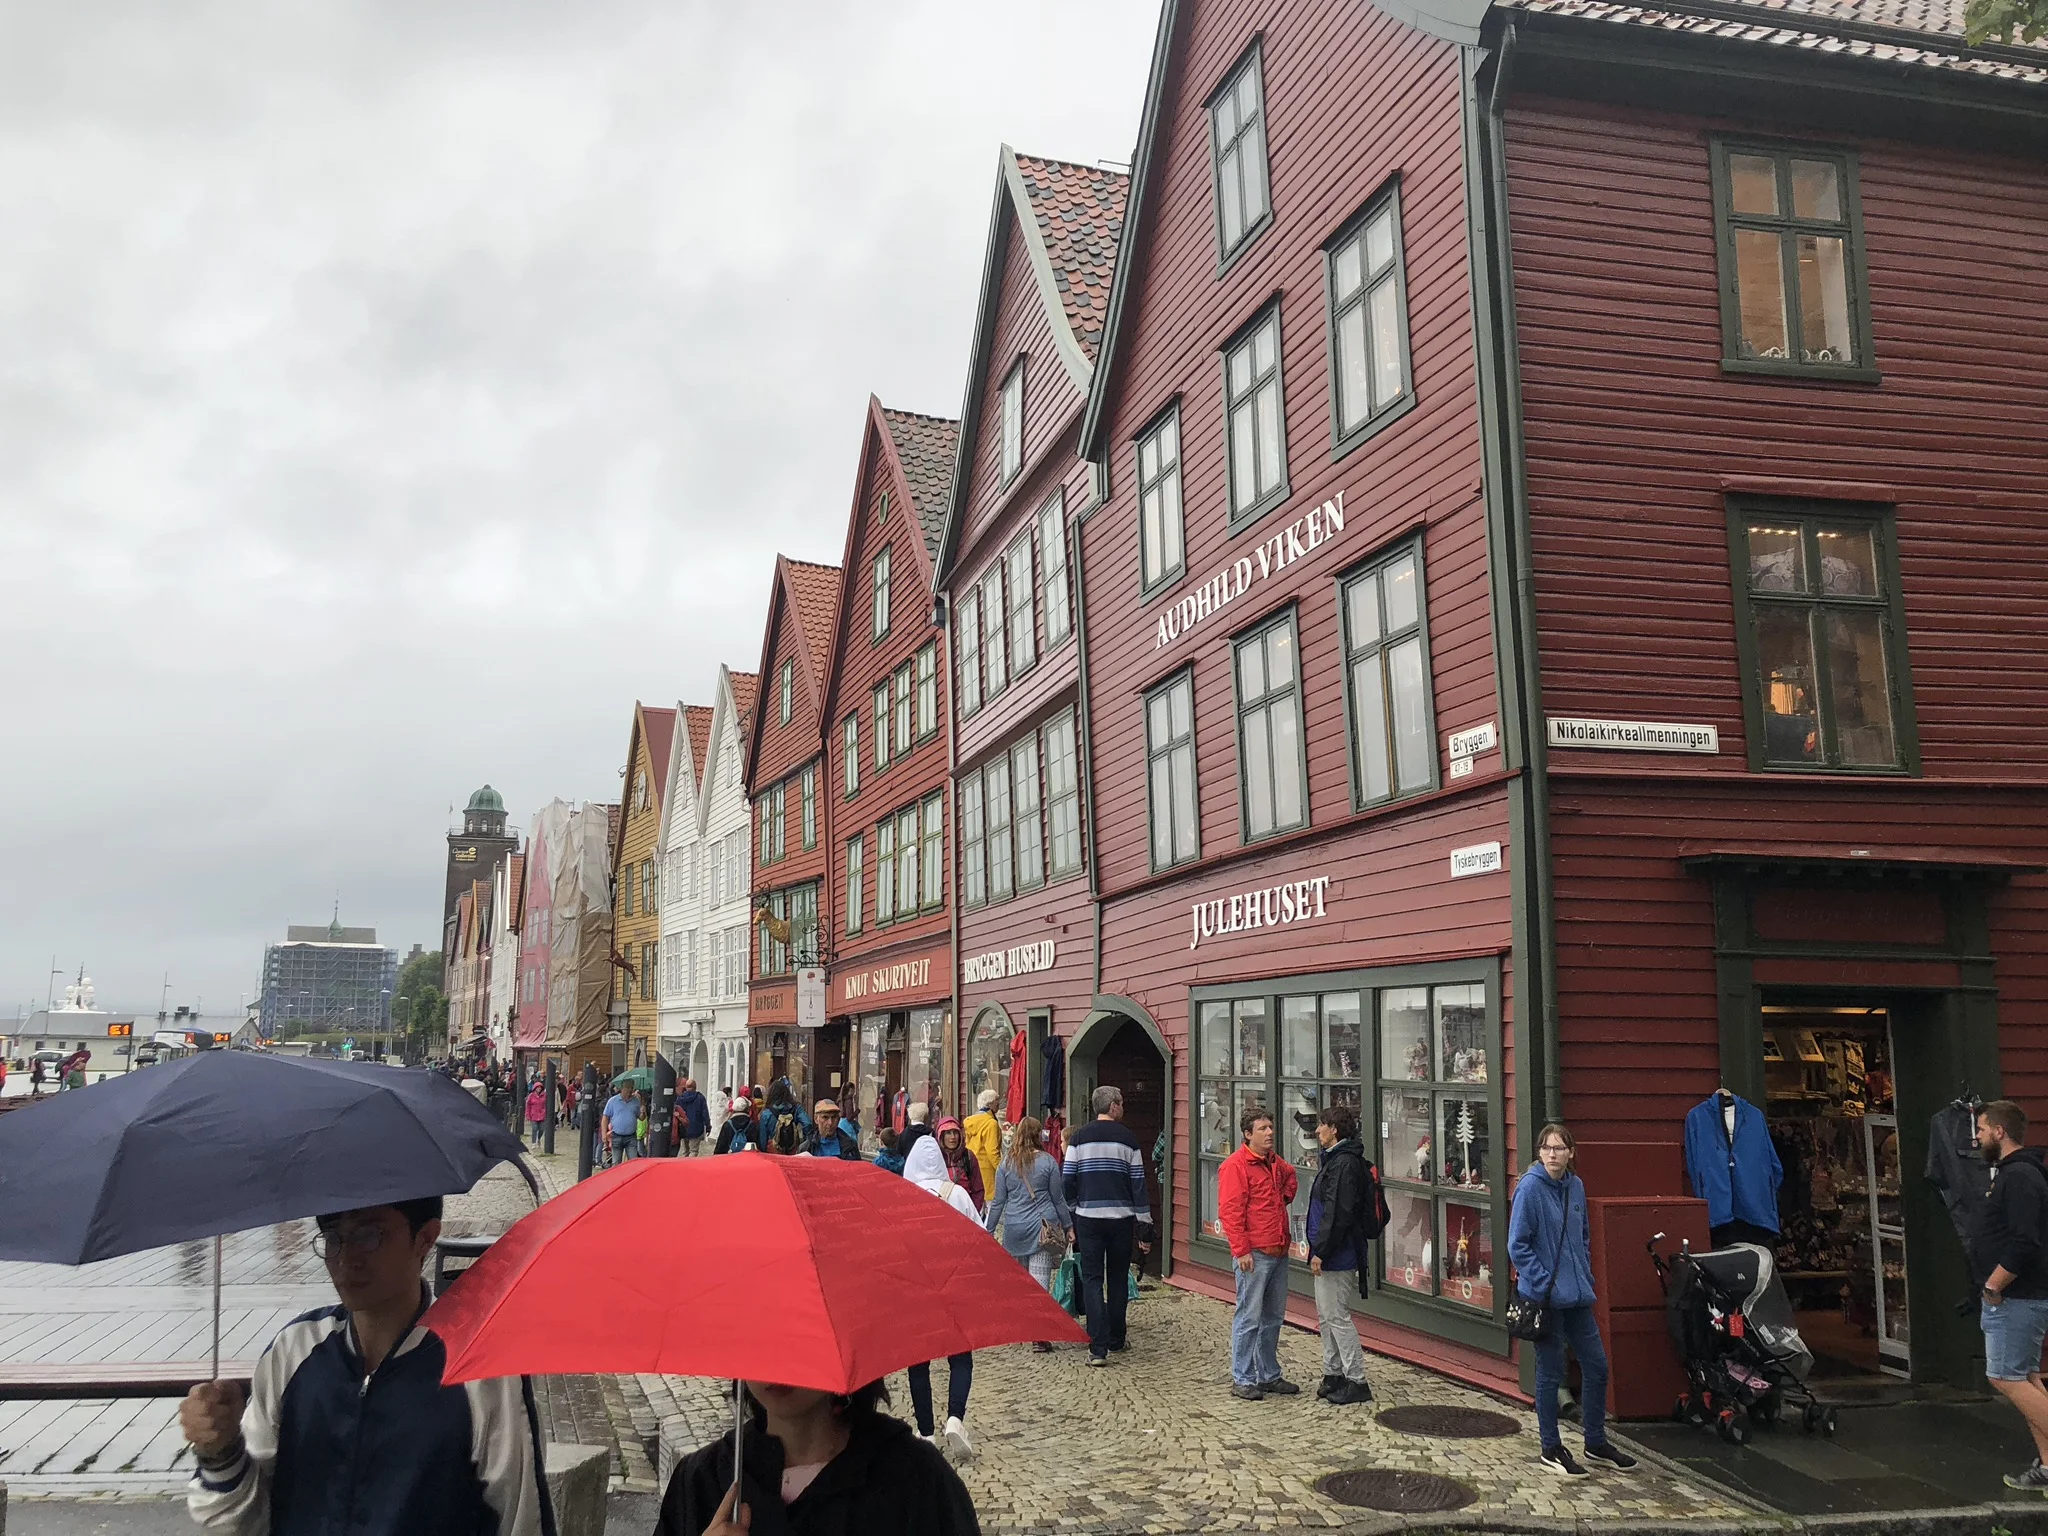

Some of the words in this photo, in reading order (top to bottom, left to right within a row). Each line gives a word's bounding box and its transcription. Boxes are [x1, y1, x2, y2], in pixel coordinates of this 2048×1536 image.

[1155, 556, 1253, 650] AUDHILD
[1255, 489, 1346, 580] VIKEN
[1453, 732, 1488, 753] Bryggen
[1556, 721, 1711, 748] Nikolaikirkeallmenningen
[1453, 851, 1498, 872] Tyskebryggen
[1190, 875, 1330, 950] JULEHUSET
[845, 972, 869, 1000] KNUT
[872, 958, 931, 994] SKURTVEIT
[964, 950, 1006, 984] BRYGGEN
[1007, 939, 1056, 977] HUSFLID
